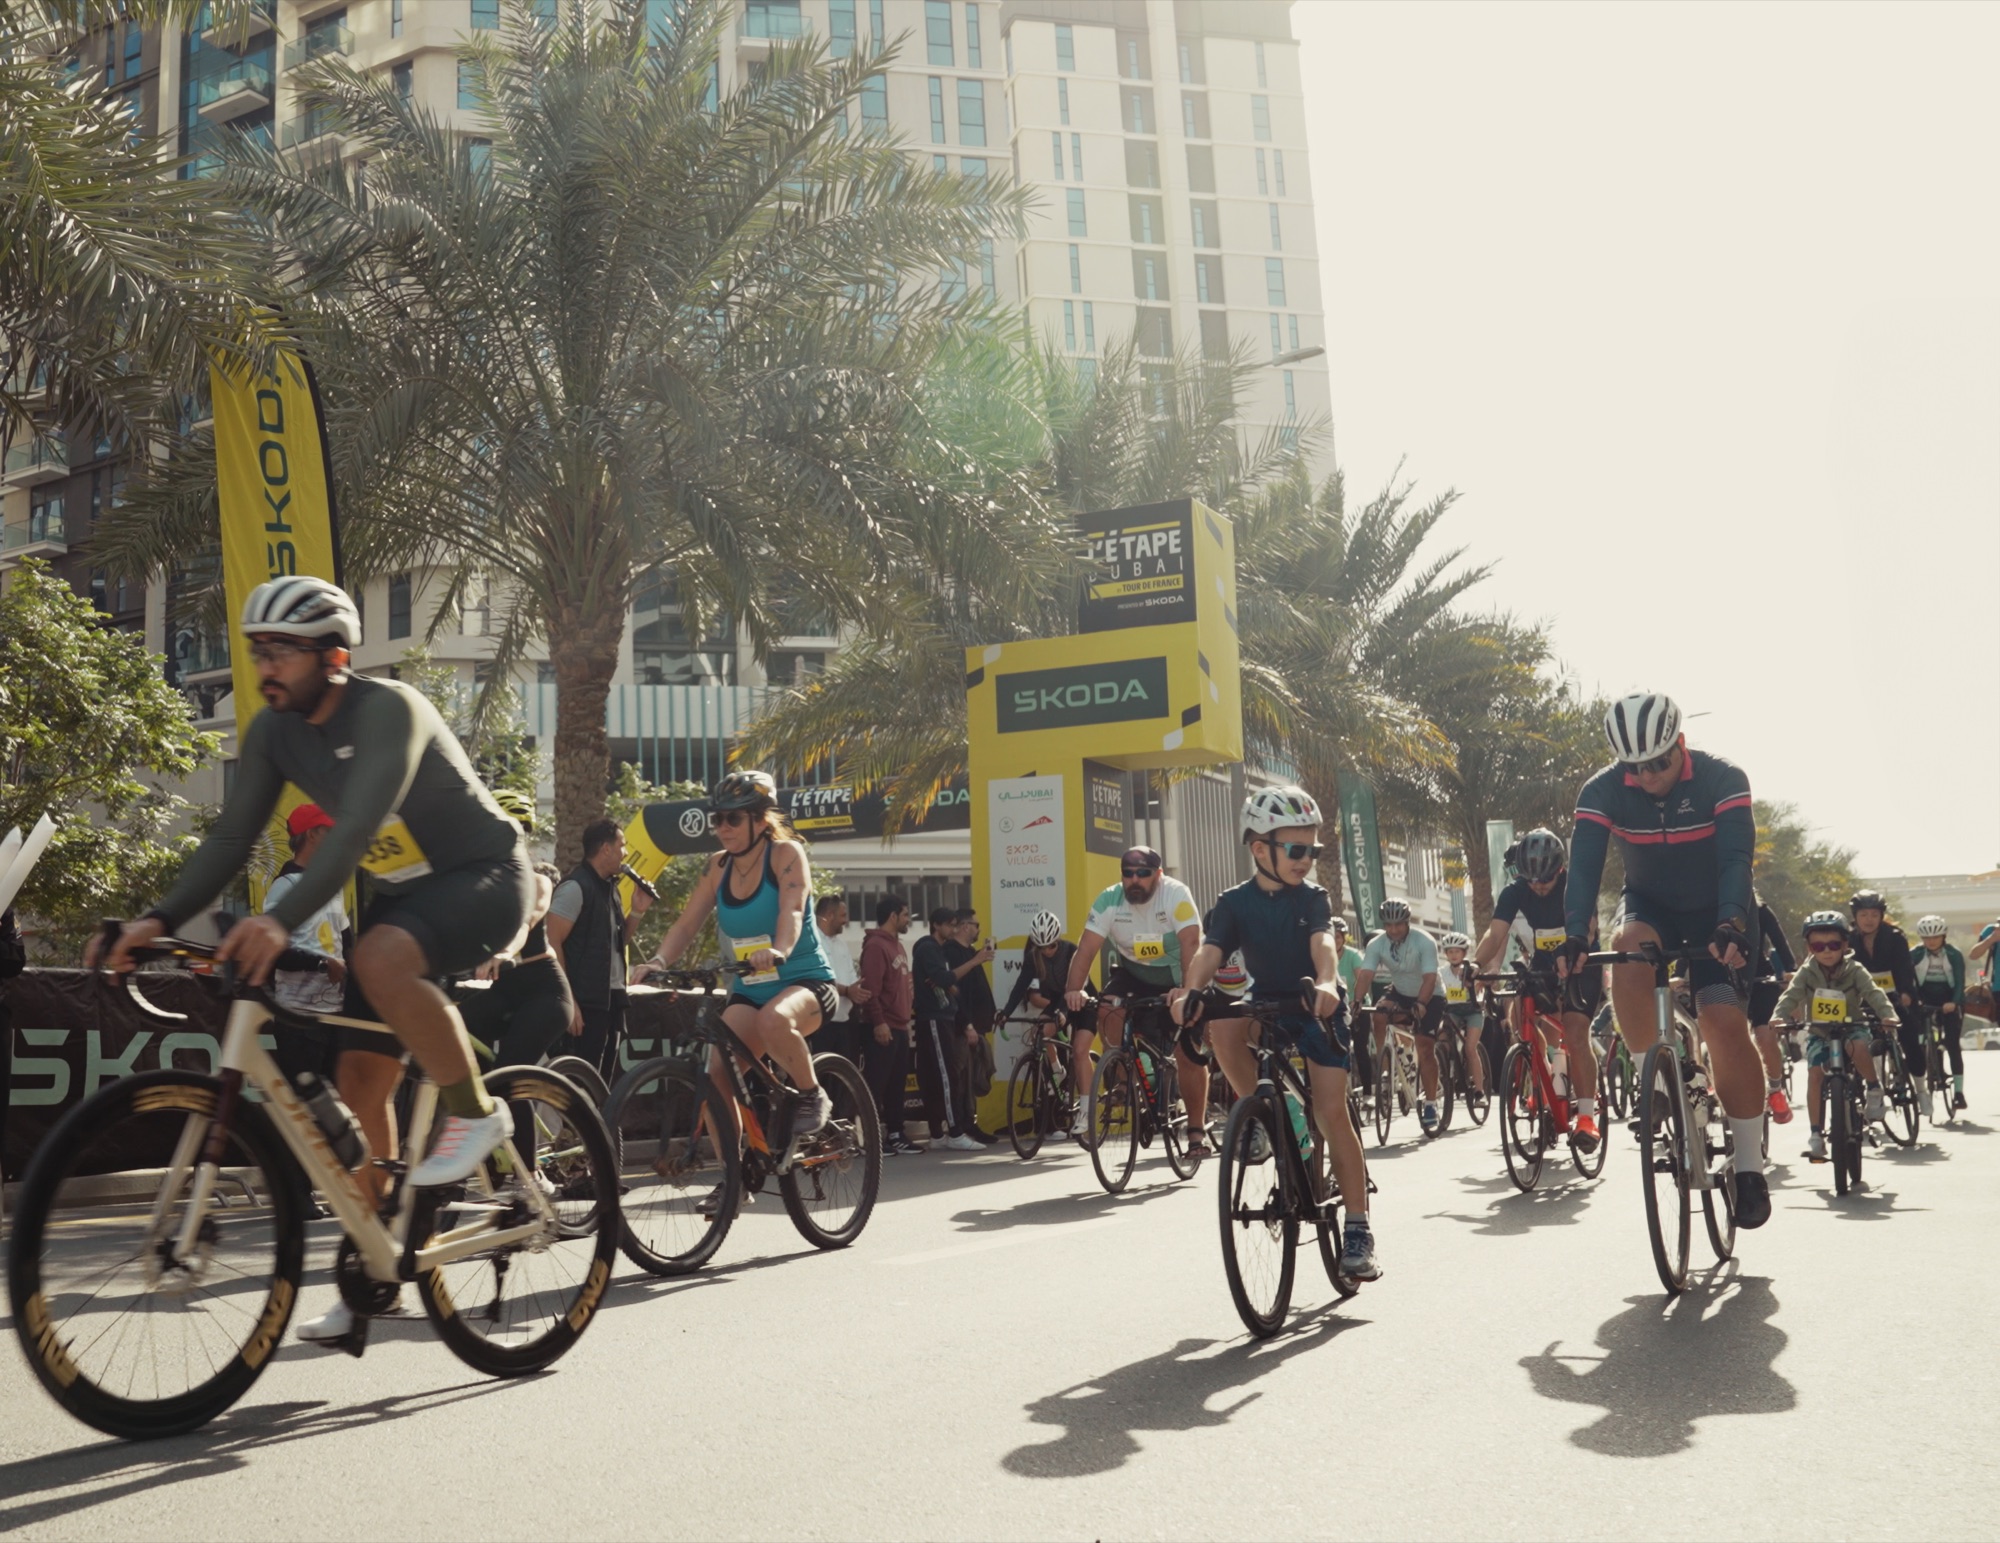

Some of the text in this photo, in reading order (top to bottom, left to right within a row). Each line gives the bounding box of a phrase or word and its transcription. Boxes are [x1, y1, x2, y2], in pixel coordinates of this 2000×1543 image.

[1123, 583, 1141, 592] TOUR
[1143, 581, 1151, 590] DE
[1153, 577, 1181, 588] FRANCE
[1145, 595, 1184, 606] SKODA
[1014, 679, 1149, 713] SKODA
[791, 803, 852, 819] DUBAI
[1093, 803, 1123, 821] DUBAI
[1006, 844, 1039, 855] EXPO
[1006, 854, 1048, 866] VILLAGE
[1000, 877, 1045, 889] SanaClis
[1140, 946, 1159, 956] 610
[1817, 1002, 1840, 1016] 556
